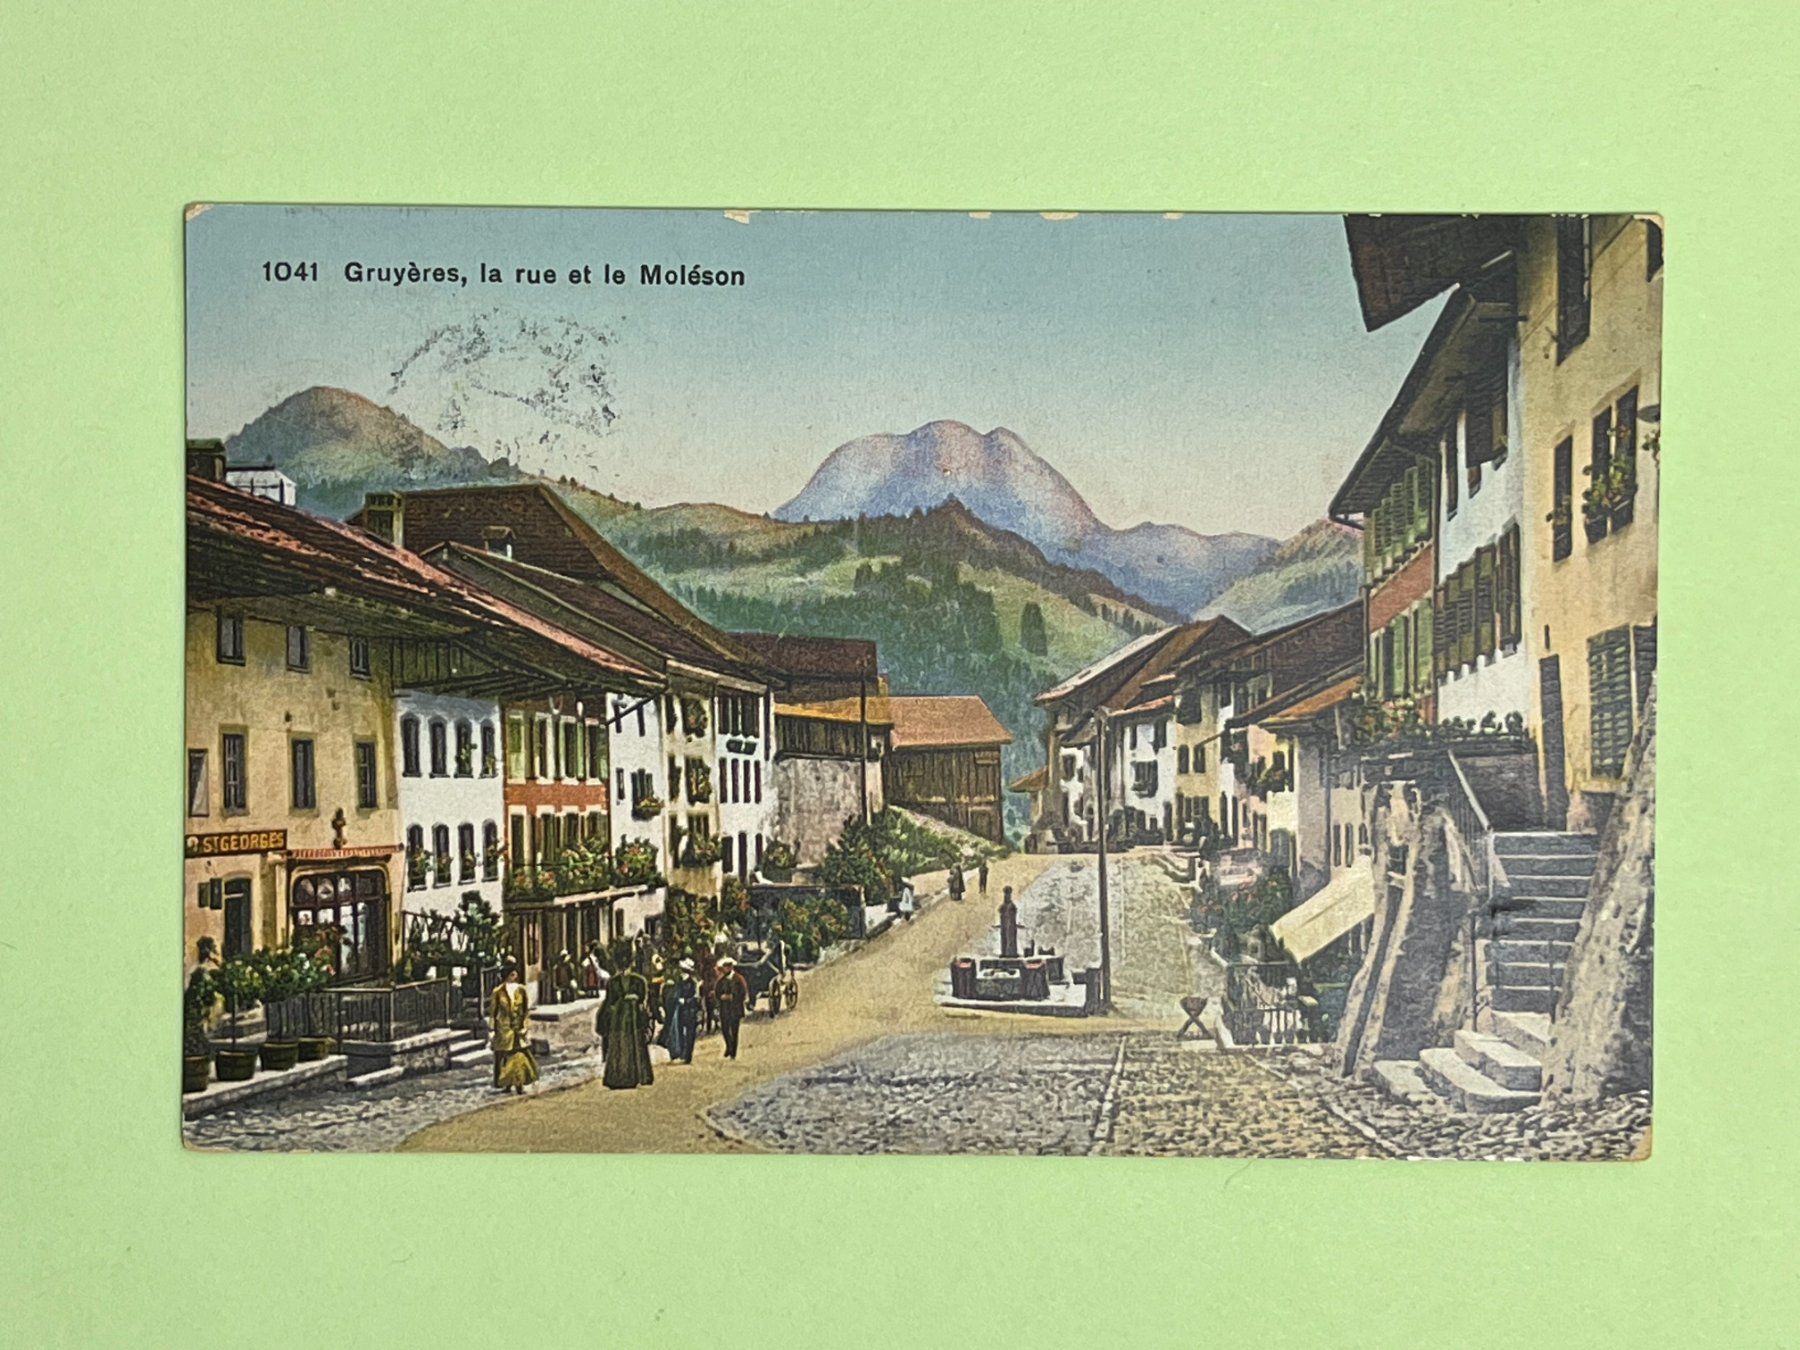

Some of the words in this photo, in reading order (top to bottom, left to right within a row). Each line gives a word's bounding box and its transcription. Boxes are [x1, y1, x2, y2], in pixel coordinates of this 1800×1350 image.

[262, 260, 318, 283] 1041
[344, 260, 468, 288] Gruyères,
[480, 262, 503, 284] la
[515, 267, 558, 285] rue
[567, 265, 593, 286] et
[603, 263, 627, 286] le
[640, 263, 746, 287] Moléson
